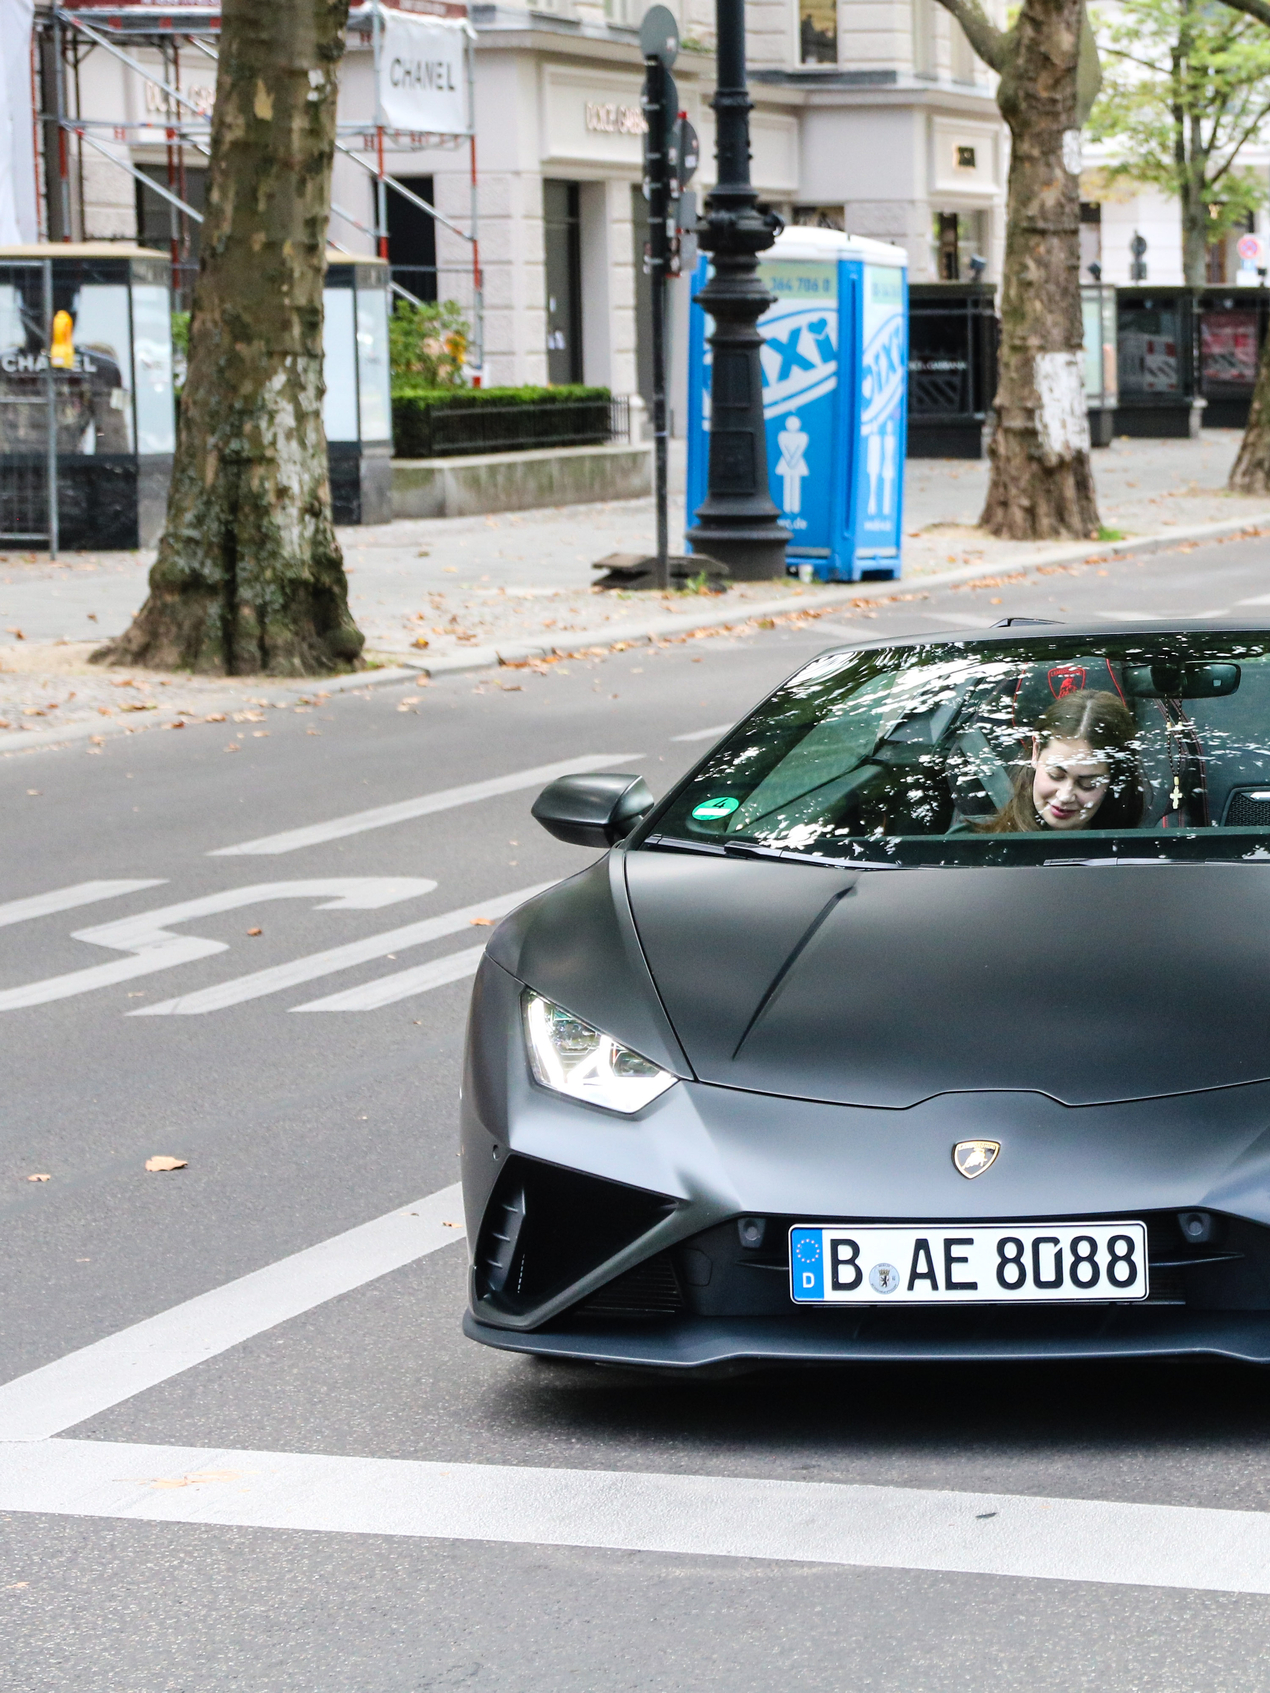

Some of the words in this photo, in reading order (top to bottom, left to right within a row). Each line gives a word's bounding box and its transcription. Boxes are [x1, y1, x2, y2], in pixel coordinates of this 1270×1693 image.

[390, 58, 456, 92] CHANEL
[1, 354, 98, 374] CHAEL
[830, 1238, 863, 1291] B
[907, 1237, 978, 1291] AE
[996, 1234, 1138, 1290] 8088
[802, 1272, 815, 1288] D
